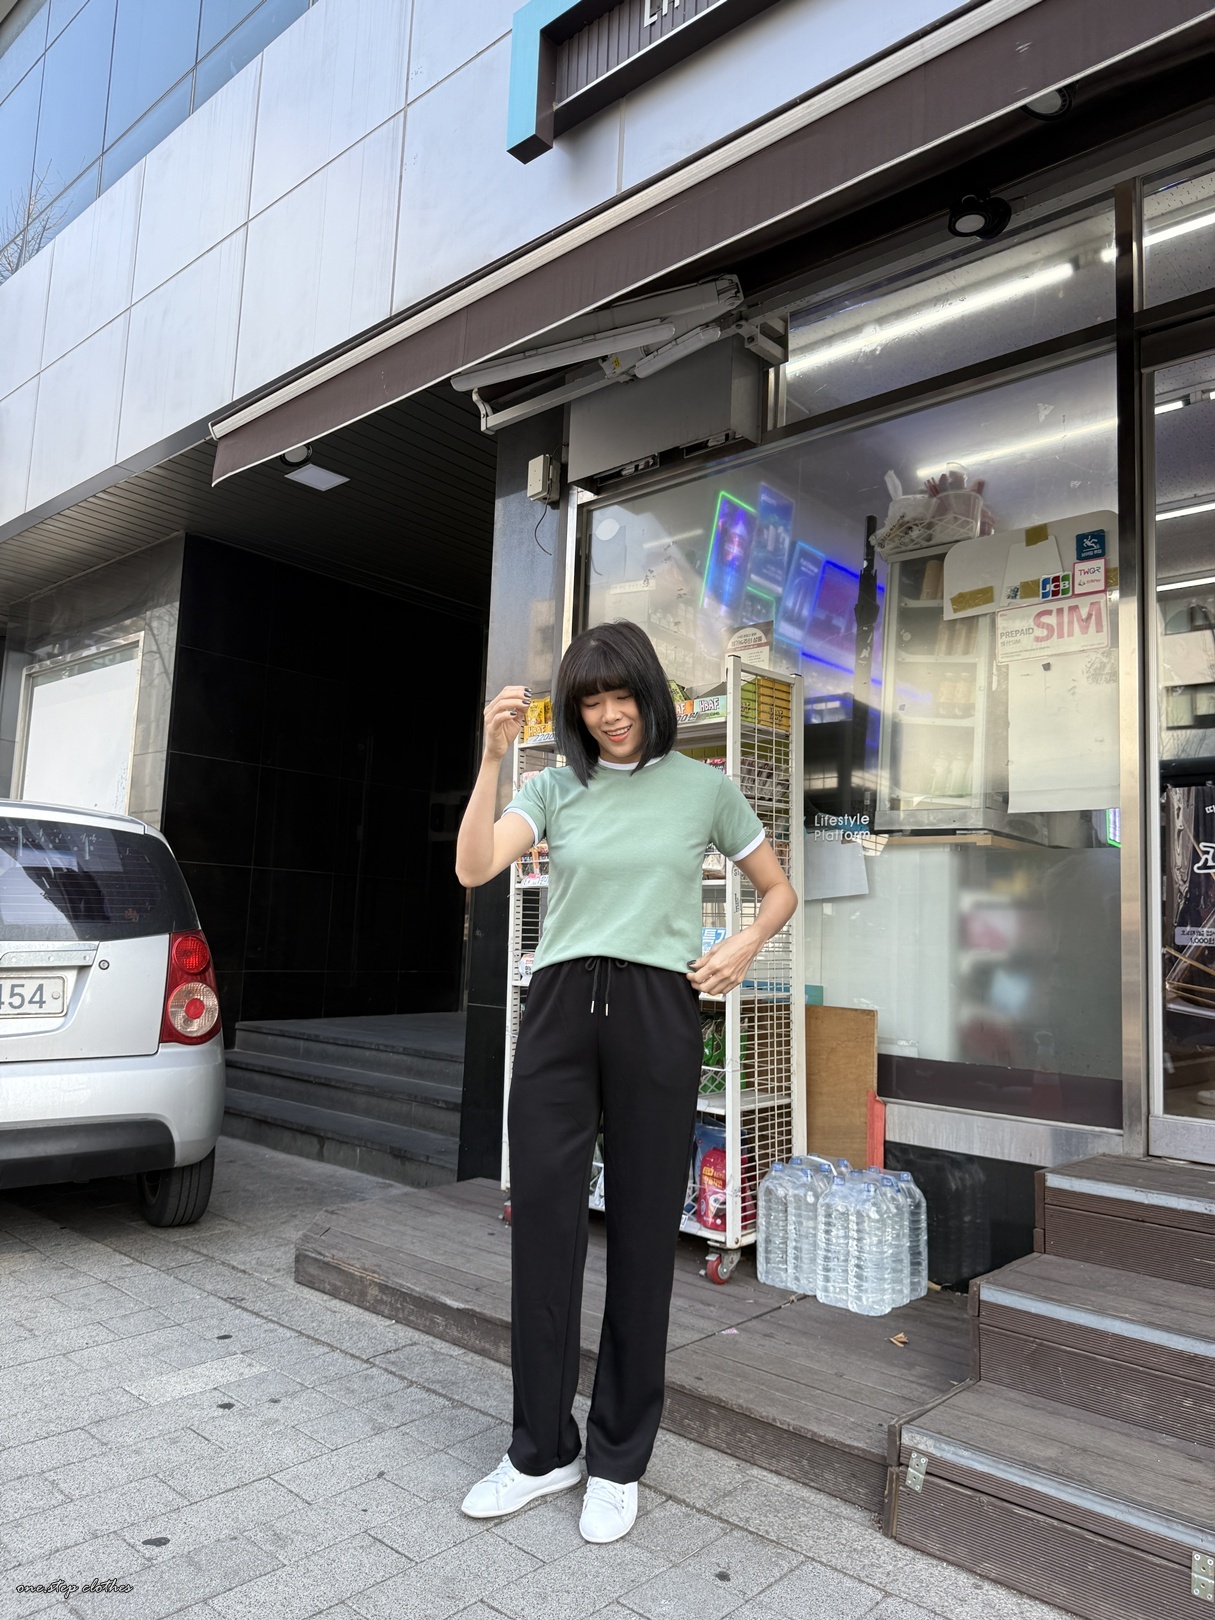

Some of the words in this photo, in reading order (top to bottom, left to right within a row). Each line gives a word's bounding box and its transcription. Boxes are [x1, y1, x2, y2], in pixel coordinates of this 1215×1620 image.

[1033, 601, 1104, 643] SIM
[1000, 627, 1035, 640] PREPAID
[814, 813, 870, 827] Lifestyle
[814, 829, 871, 841] Platform
[0, 983, 47, 1010] 54
